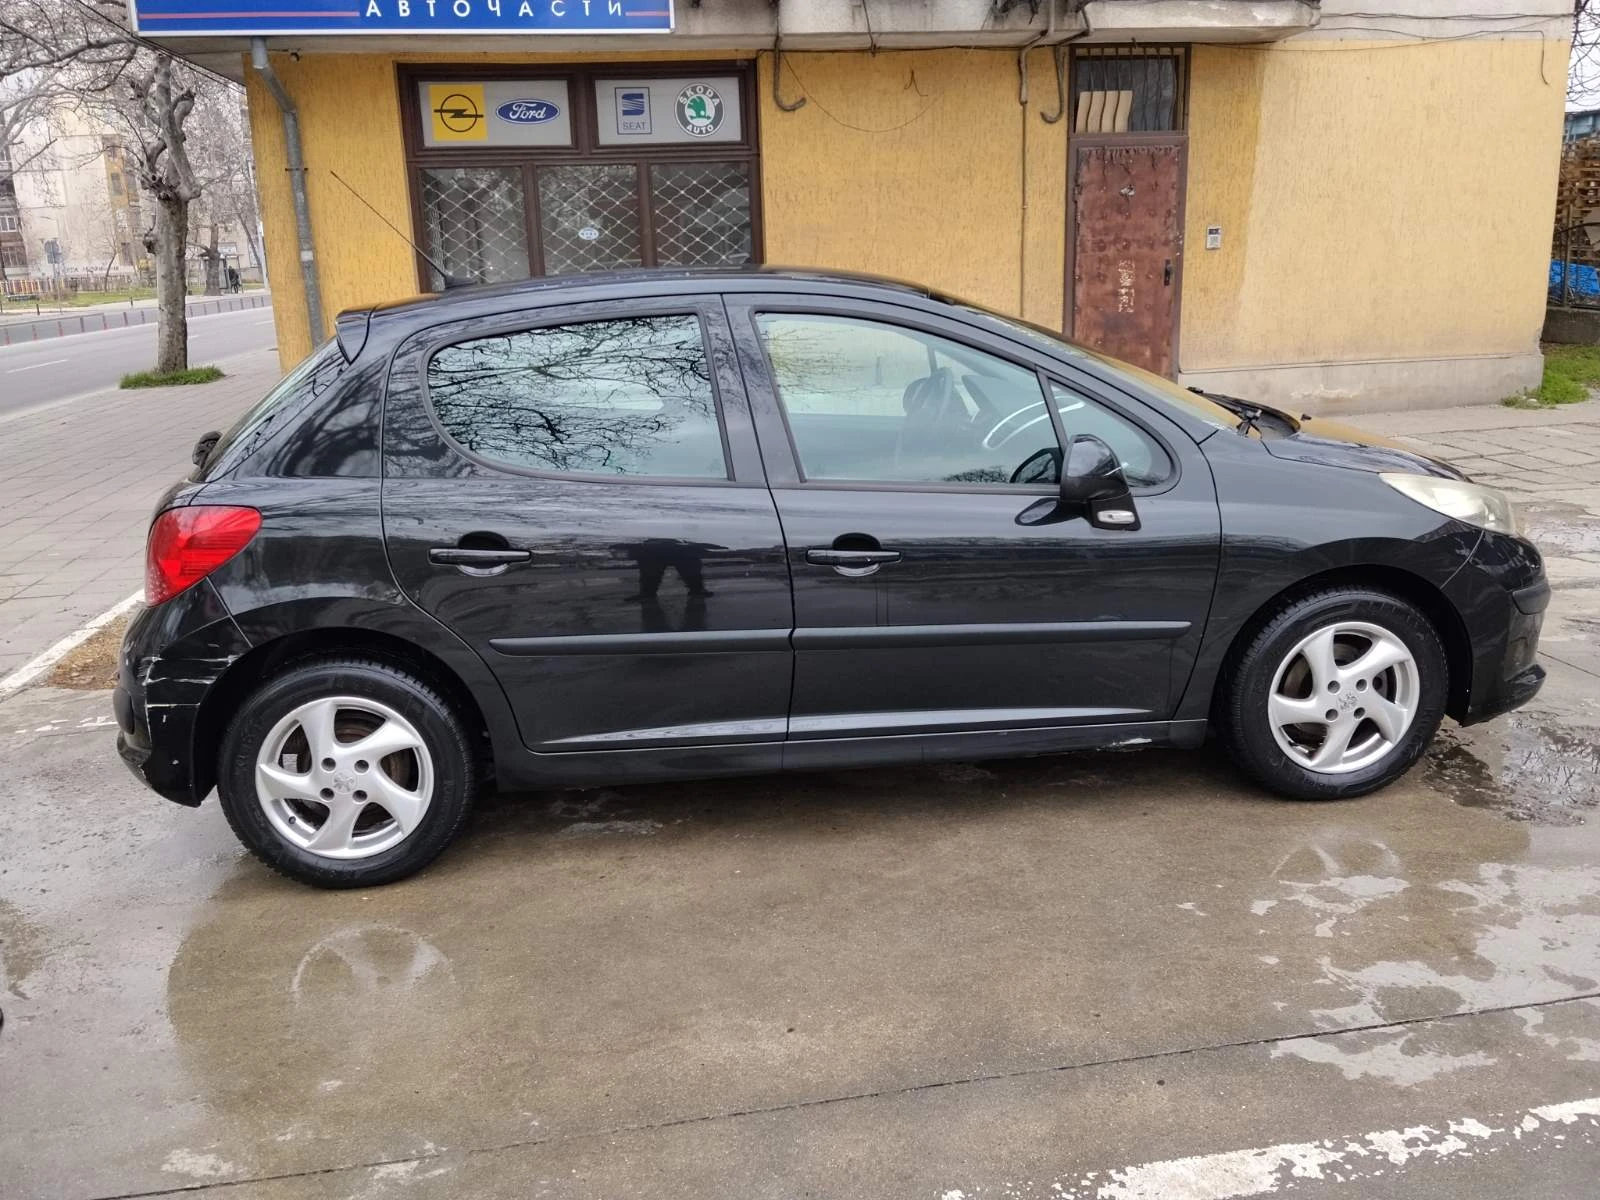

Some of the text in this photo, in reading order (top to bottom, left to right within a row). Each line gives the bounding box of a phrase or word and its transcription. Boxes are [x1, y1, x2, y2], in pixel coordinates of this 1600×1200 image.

[366, 0, 622, 17] АВТОЧАСТИ
[679, 85, 720, 106] SKODA
[509, 102, 546, 119] Ford
[622, 121, 648, 131] SEAT
[686, 123, 714, 134] AUTO
